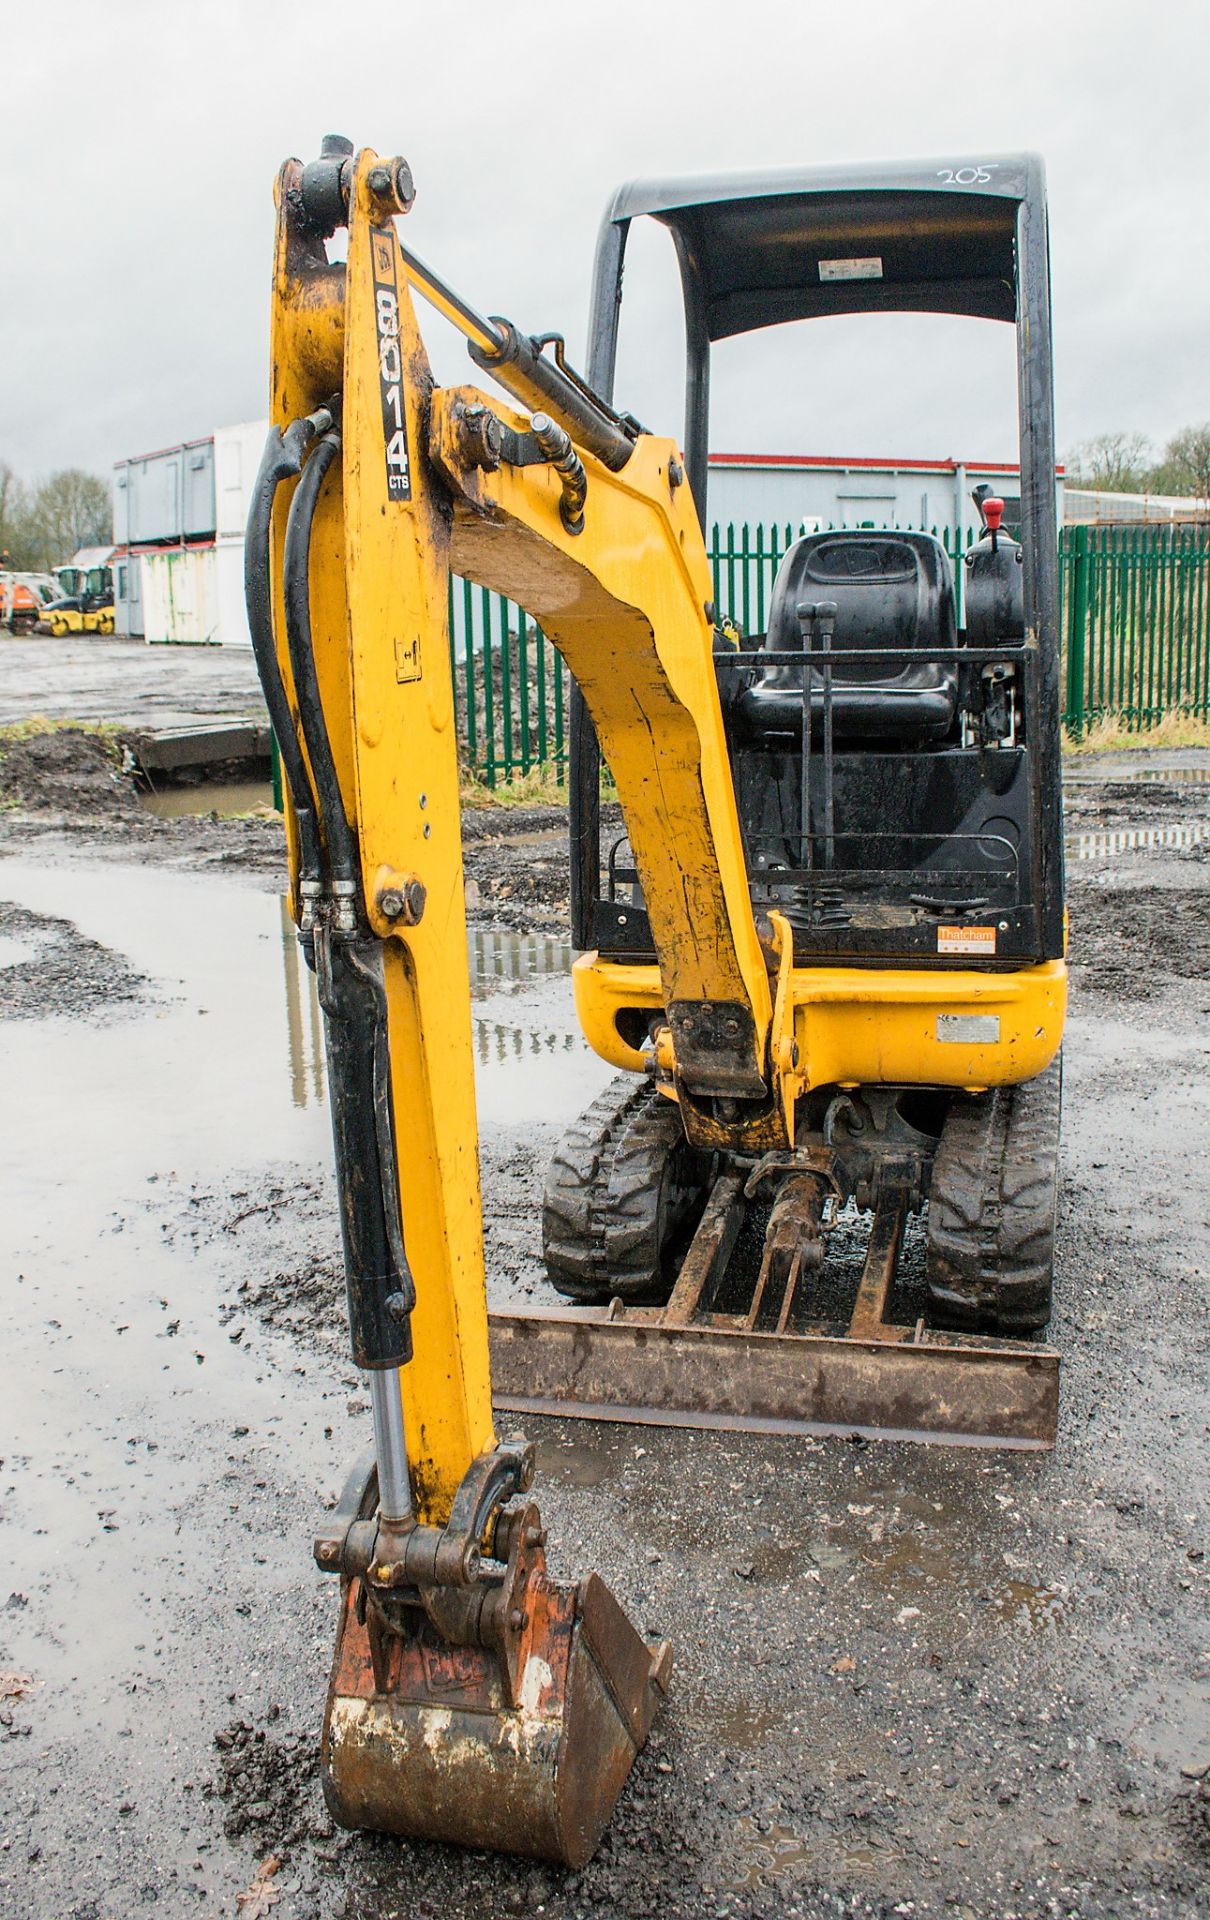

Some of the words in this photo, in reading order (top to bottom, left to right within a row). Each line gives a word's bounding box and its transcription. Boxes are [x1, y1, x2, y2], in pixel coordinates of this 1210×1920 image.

[937, 164, 999, 184] 205
[376, 289, 408, 473] 8014
[389, 475, 409, 489] CTS
[941, 928, 993, 940] Thatcham
